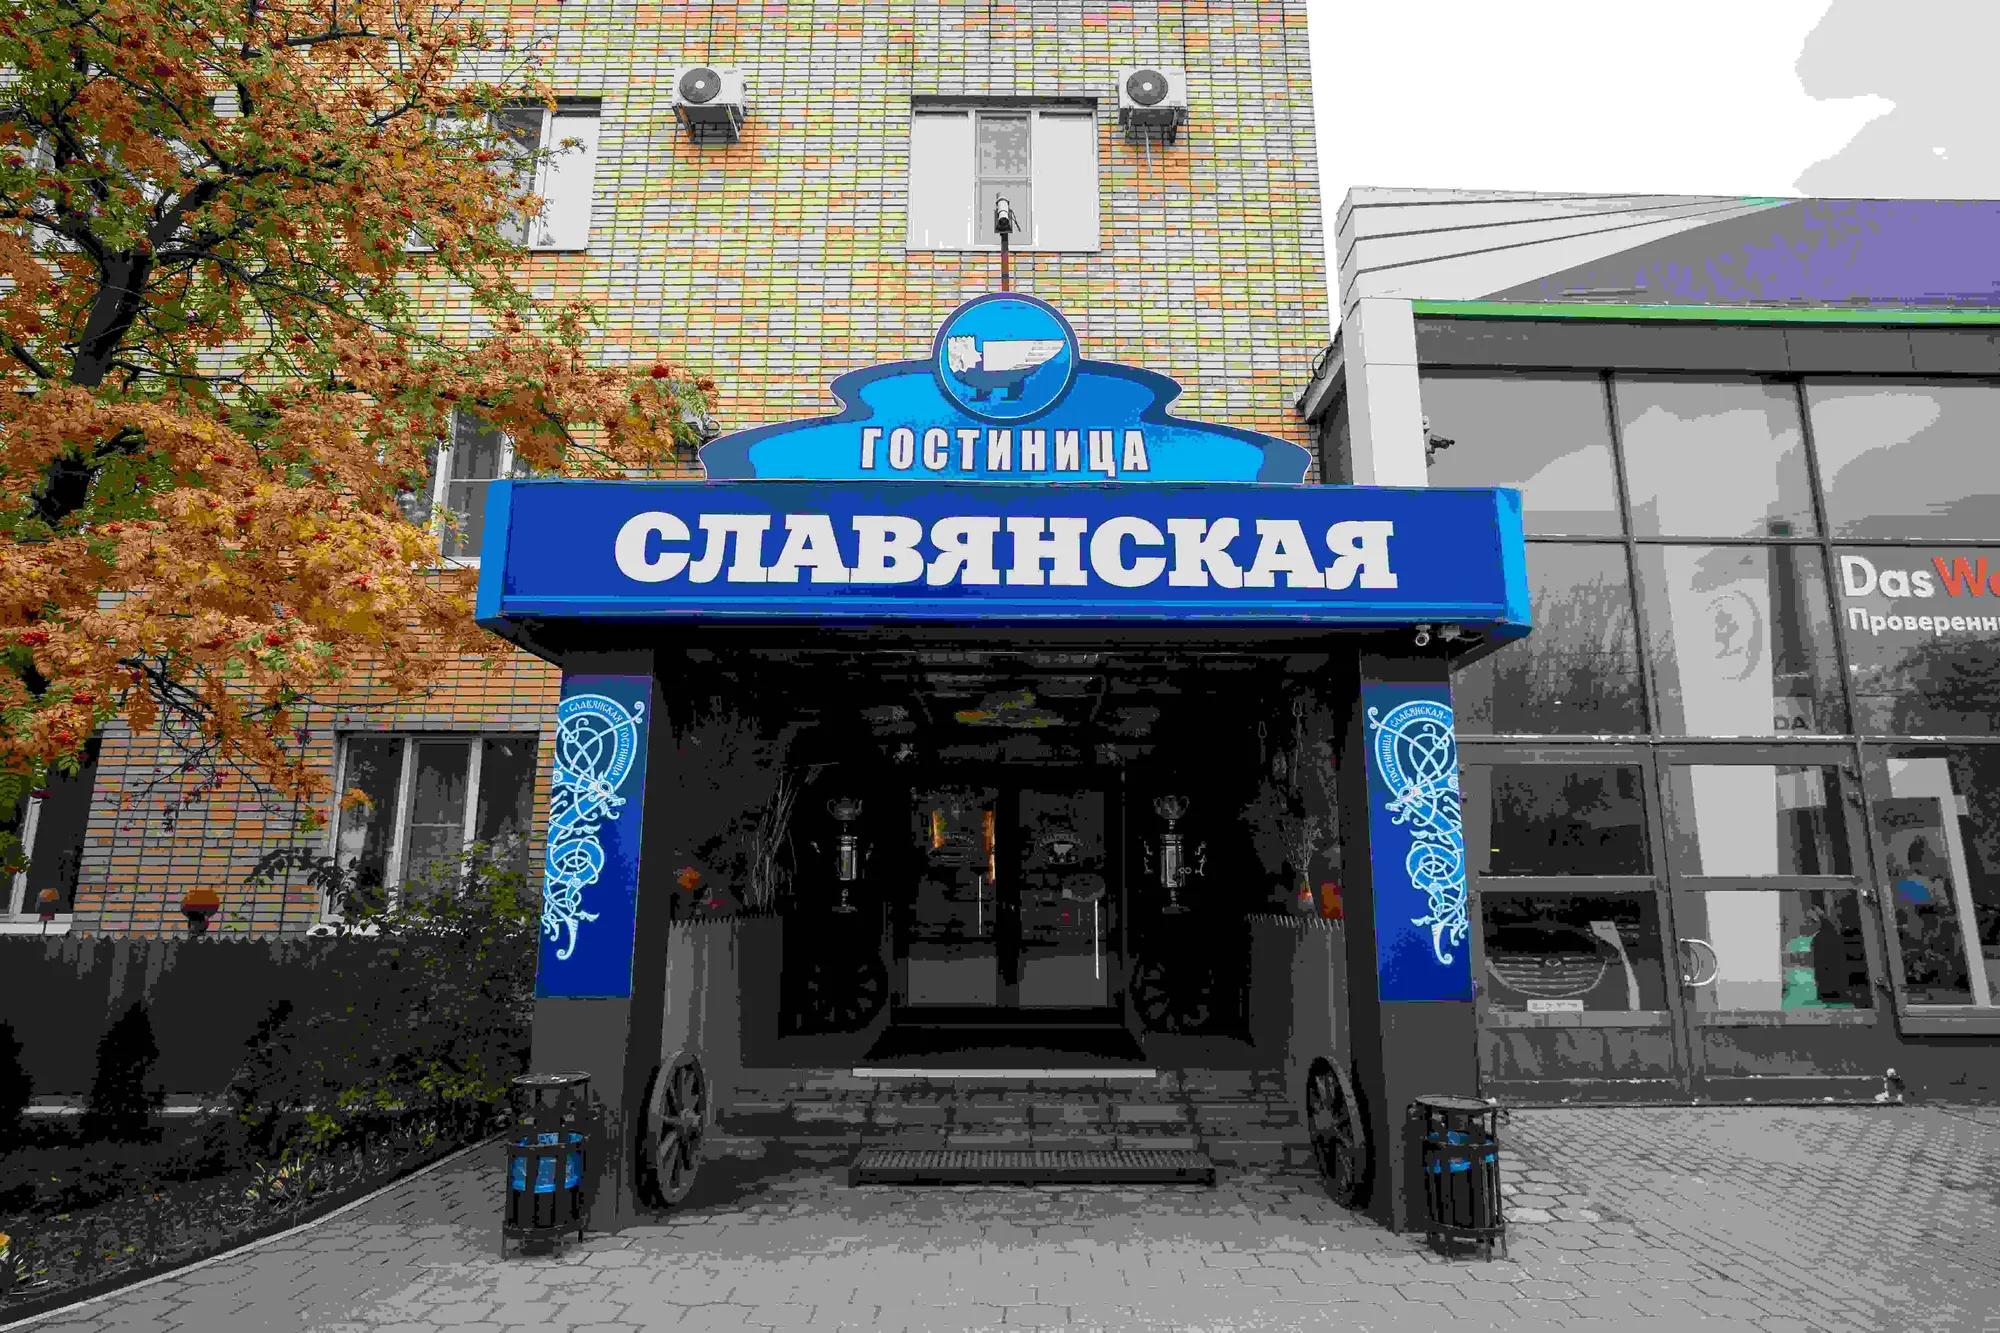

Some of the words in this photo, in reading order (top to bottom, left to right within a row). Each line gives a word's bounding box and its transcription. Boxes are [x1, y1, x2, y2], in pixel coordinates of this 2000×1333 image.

[860, 427, 1149, 478] ГОСТИНИЦА
[615, 511, 1399, 591] СЛАВЯНСКАЯ
[1848, 607, 2000, 637] Проверенн
